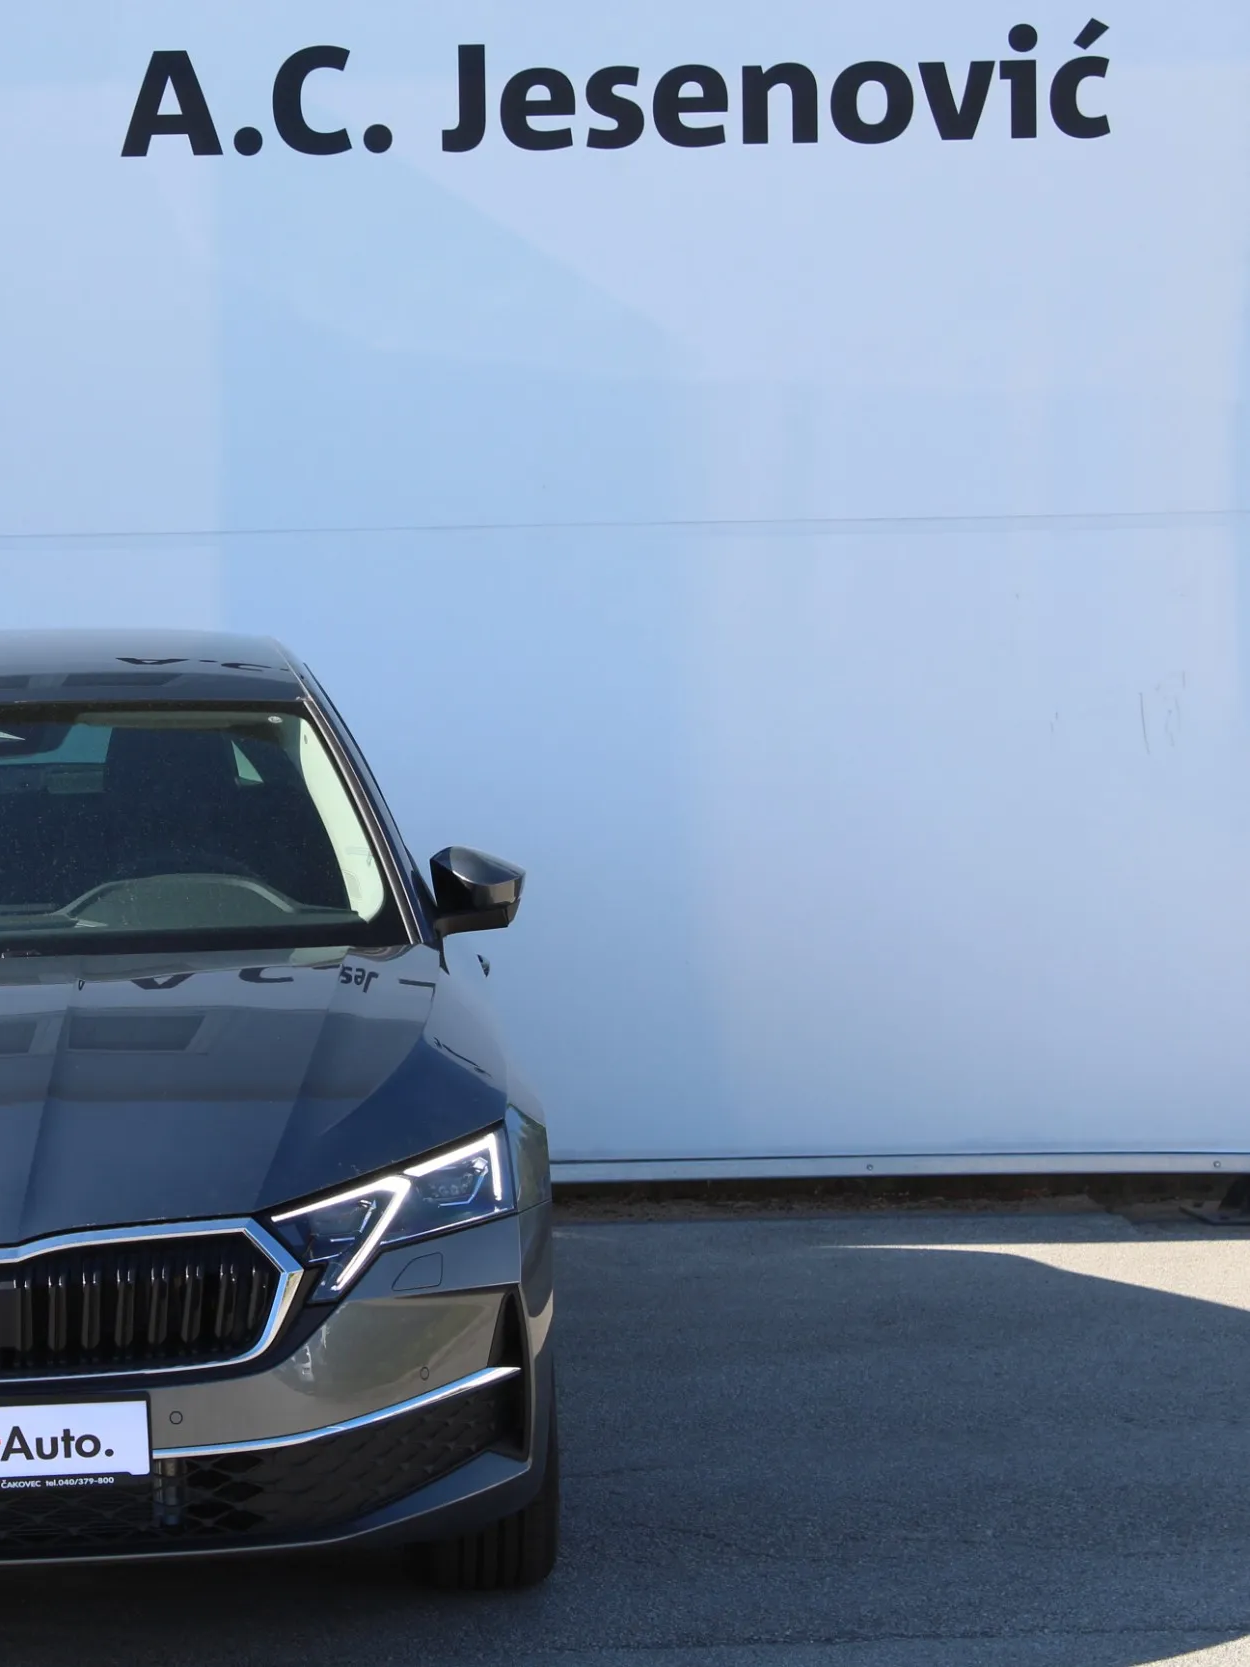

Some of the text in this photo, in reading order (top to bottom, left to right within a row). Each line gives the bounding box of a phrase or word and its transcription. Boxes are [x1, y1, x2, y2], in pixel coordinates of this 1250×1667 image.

[121, 18, 1111, 158] A.C. Jesenović
[0, 1479, 42, 1489] ČAKOVEC
[45, 1476, 115, 1487] tel.040/379-800
